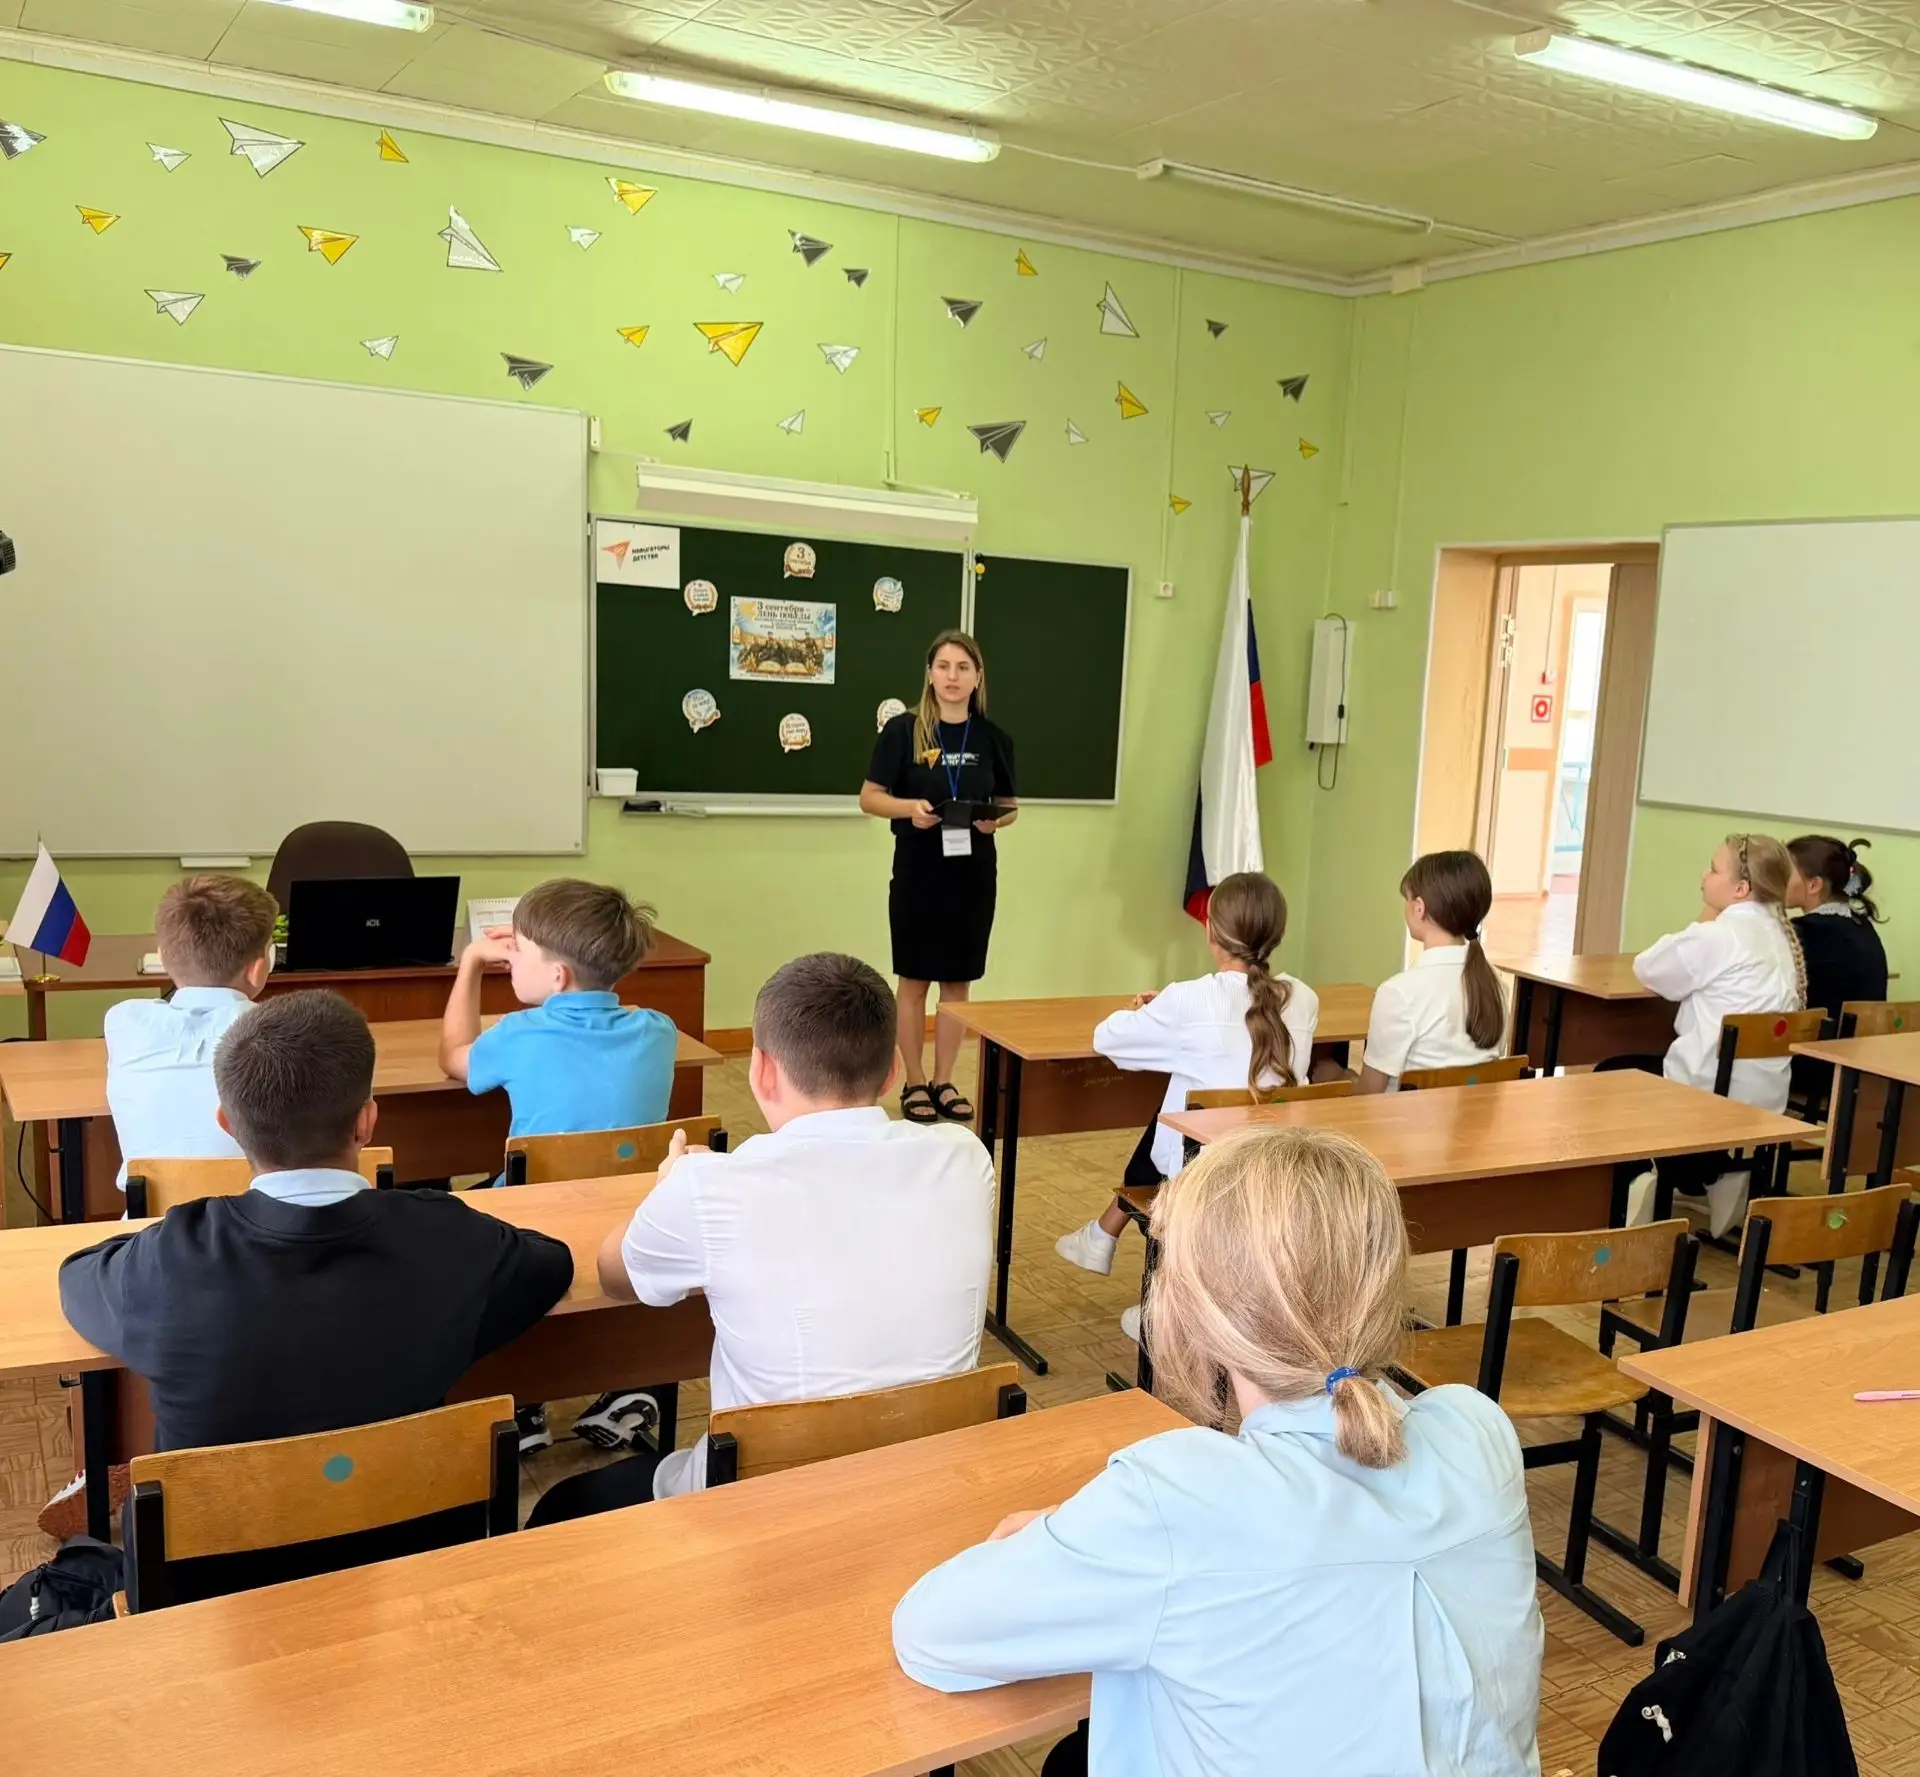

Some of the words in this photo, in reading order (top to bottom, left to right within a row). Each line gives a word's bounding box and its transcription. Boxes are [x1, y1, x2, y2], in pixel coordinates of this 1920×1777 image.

[632, 545, 670, 553] НАВИГАТОРЫ
[797, 547, 805, 559] 3
[633, 553, 658, 562] ДЕТСТВА
[757, 601, 763, 610] 3
